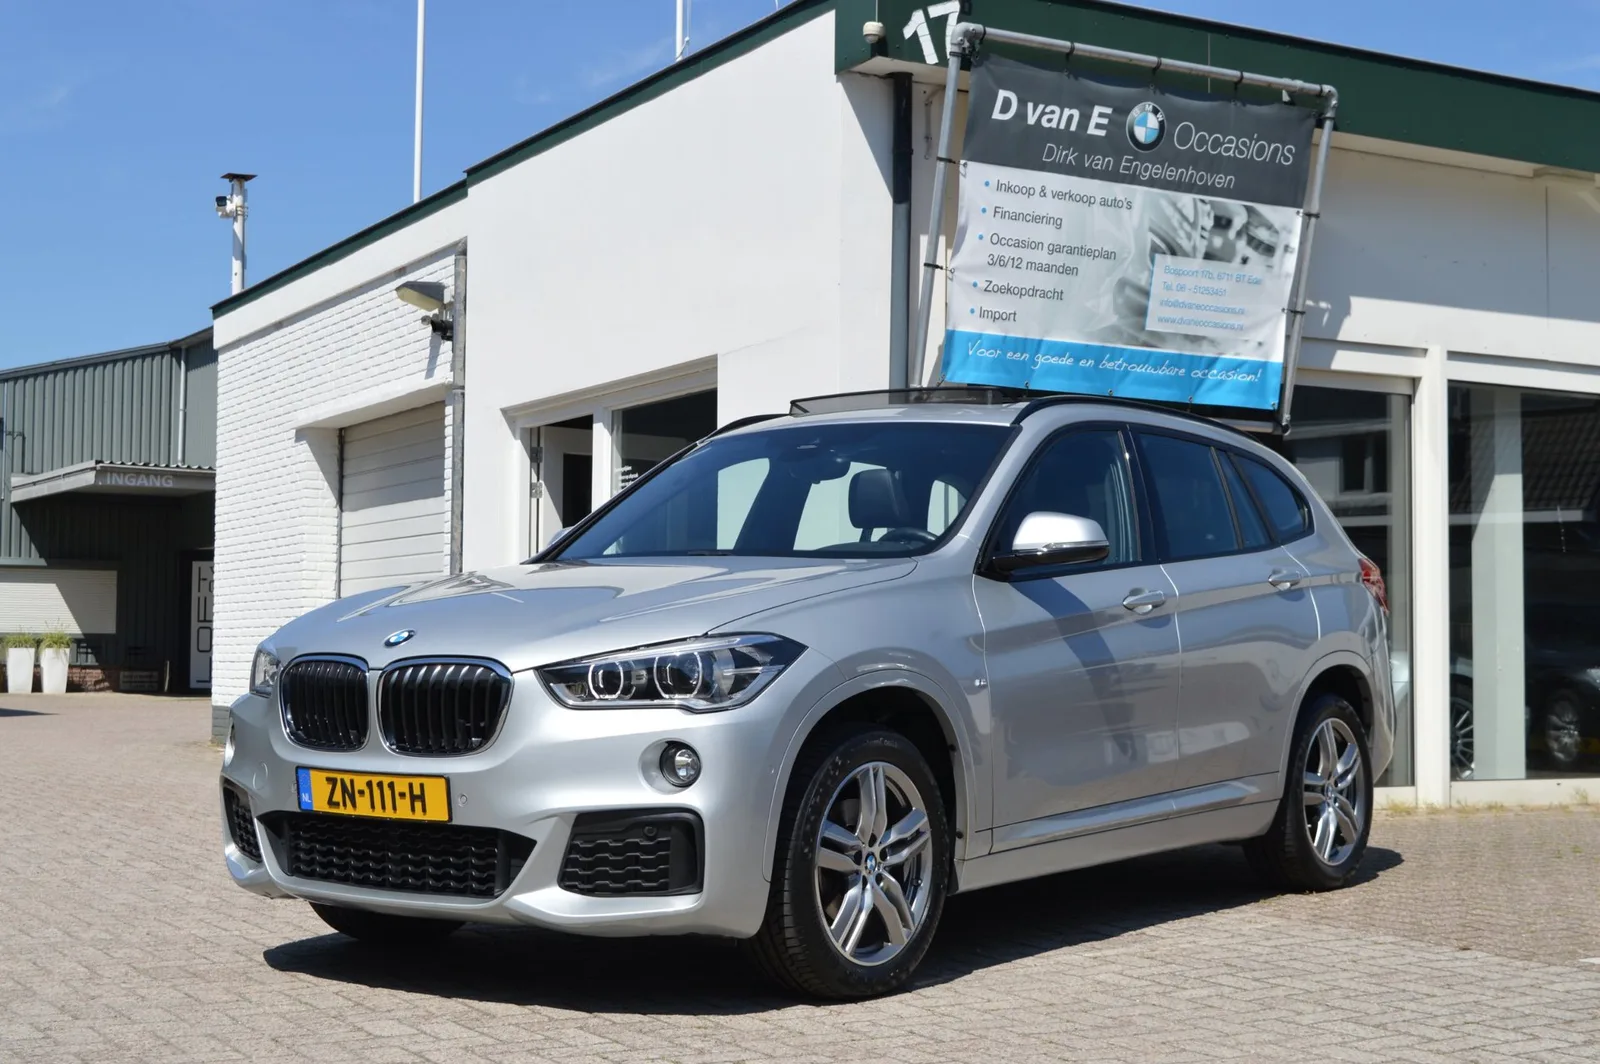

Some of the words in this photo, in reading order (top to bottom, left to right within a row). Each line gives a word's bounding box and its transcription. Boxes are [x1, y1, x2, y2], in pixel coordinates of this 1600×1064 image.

[902, 0, 960, 64] 17
[991, 88, 1018, 121] D
[1026, 101, 1080, 132] van
[1086, 104, 1113, 137] E
[1174, 122, 1296, 166] Occasions
[1042, 143, 1079, 165] Dirk
[1084, 153, 1114, 171] van
[1119, 155, 1236, 189] Engelenhoven
[996, 179, 1036, 198] Inkoop
[1038, 185, 1047, 199] &
[1051, 189, 1096, 207] verkoop
[1099, 197, 1133, 211] auto's
[993, 206, 1063, 230] Financiering
[990, 232, 1044, 252] Occasion
[1047, 242, 1117, 261] garantieplan
[987, 253, 1024, 270] 3/6/12
[1026, 260, 1079, 276] maanden
[984, 279, 1064, 301] Zoekopdracht
[979, 306, 1017, 323] Import
[968, 339, 1001, 359] Voor
[1006, 351, 1030, 361] een
[1031, 352, 1074, 370] goede
[1079, 357, 1095, 368] en
[1098, 354, 1186, 377] betrouwbare
[1190, 368, 1262, 382] occasion!
[106, 472, 174, 488] INGANG
[301, 792, 312, 803] NL
[325, 776, 428, 816] ZN-111-H
